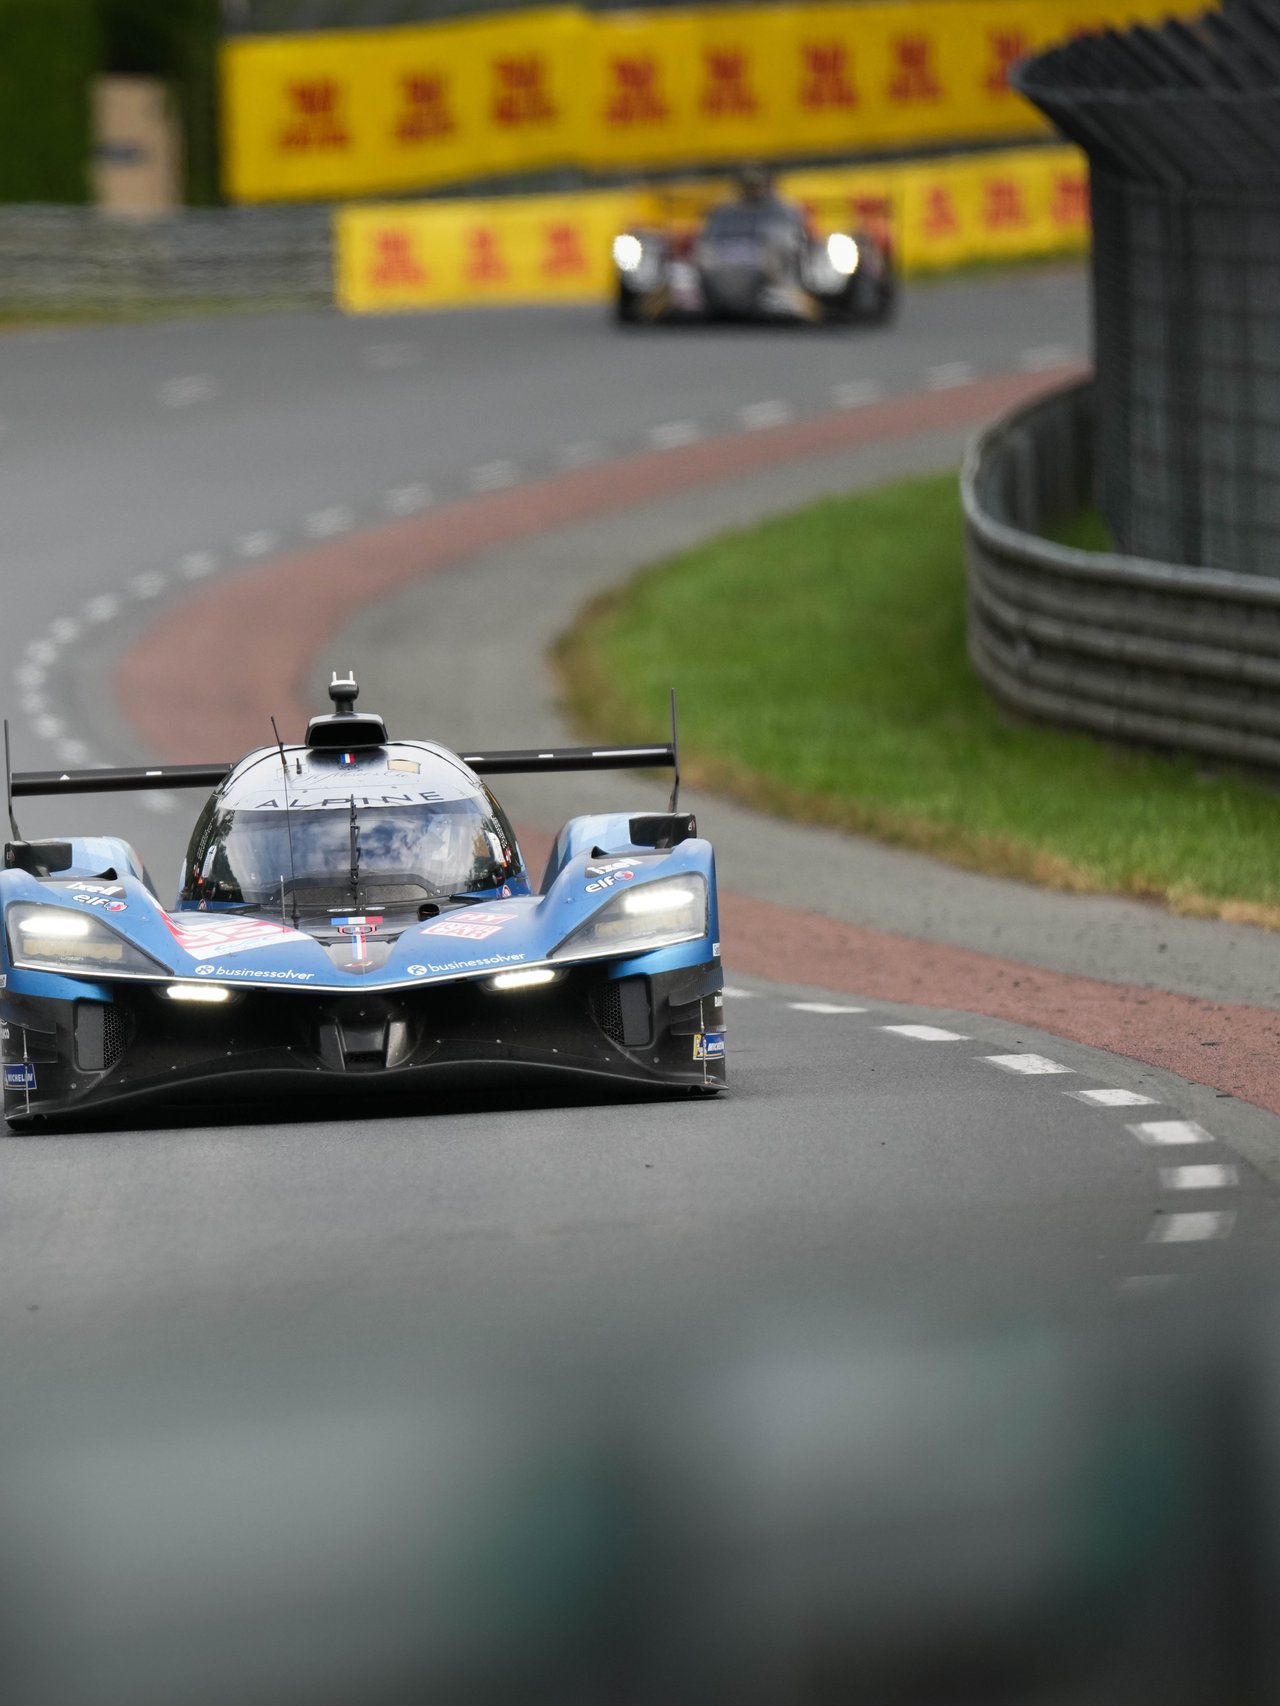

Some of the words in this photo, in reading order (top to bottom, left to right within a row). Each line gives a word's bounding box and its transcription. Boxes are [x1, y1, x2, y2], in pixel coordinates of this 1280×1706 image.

[255, 791, 445, 809] ALPINE
[585, 876, 615, 893] elf
[72, 894, 110, 906] elf
[427, 953, 526, 973] businessolver
[216, 966, 315, 980] businessolver
